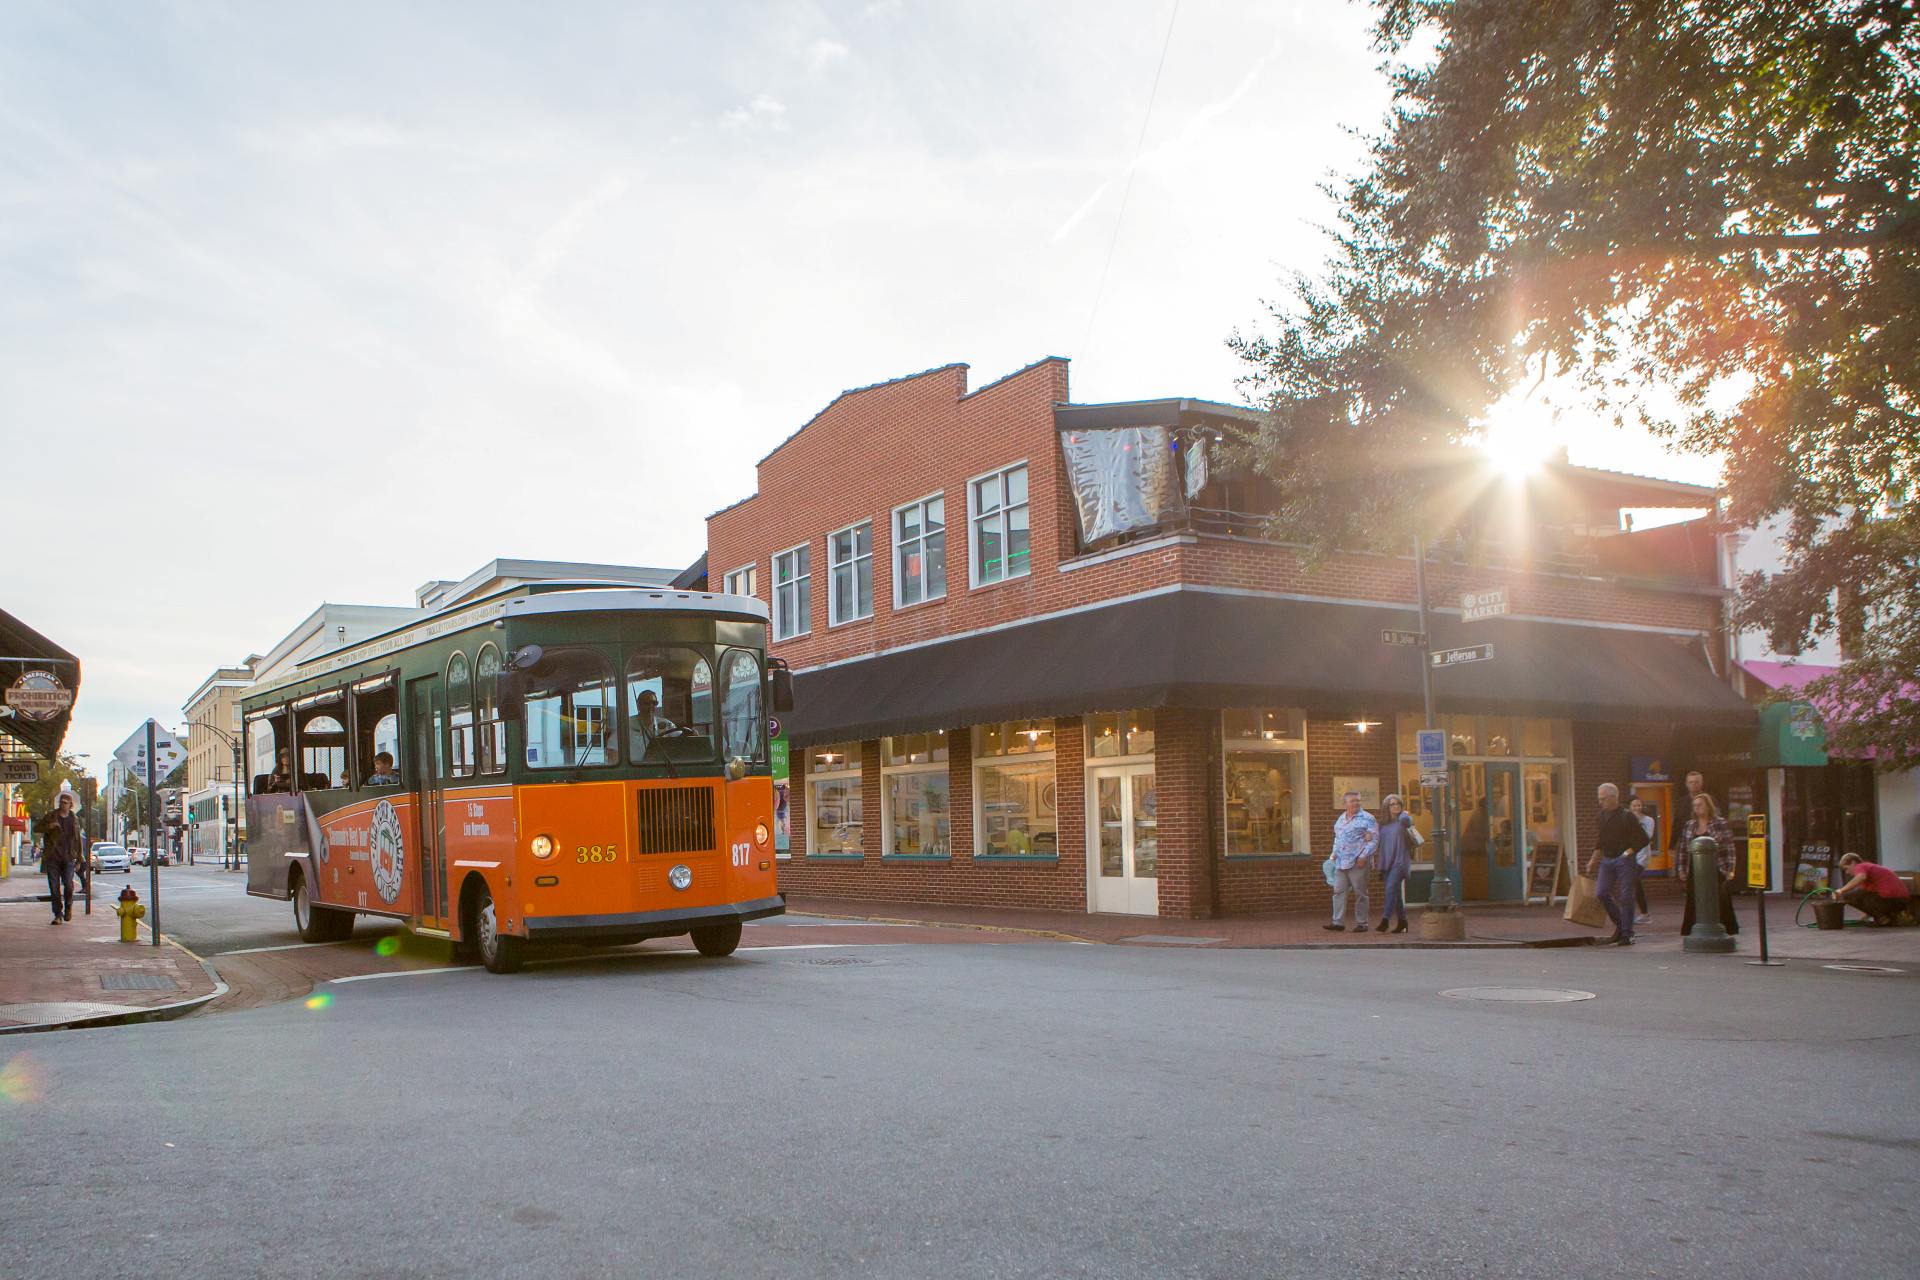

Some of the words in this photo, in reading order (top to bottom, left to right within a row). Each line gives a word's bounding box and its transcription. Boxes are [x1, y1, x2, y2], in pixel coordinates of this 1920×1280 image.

[1478, 592, 1503, 605] CITY
[1464, 603, 1506, 619] MARKET
[1446, 650, 1477, 663] Jefferson
[22, 671, 56, 682] AMERICAN
[8, 691, 70, 700] PROHIBITION
[371, 822, 379, 850] OLD
[576, 844, 617, 864] 385
[731, 843, 750, 866] 817
